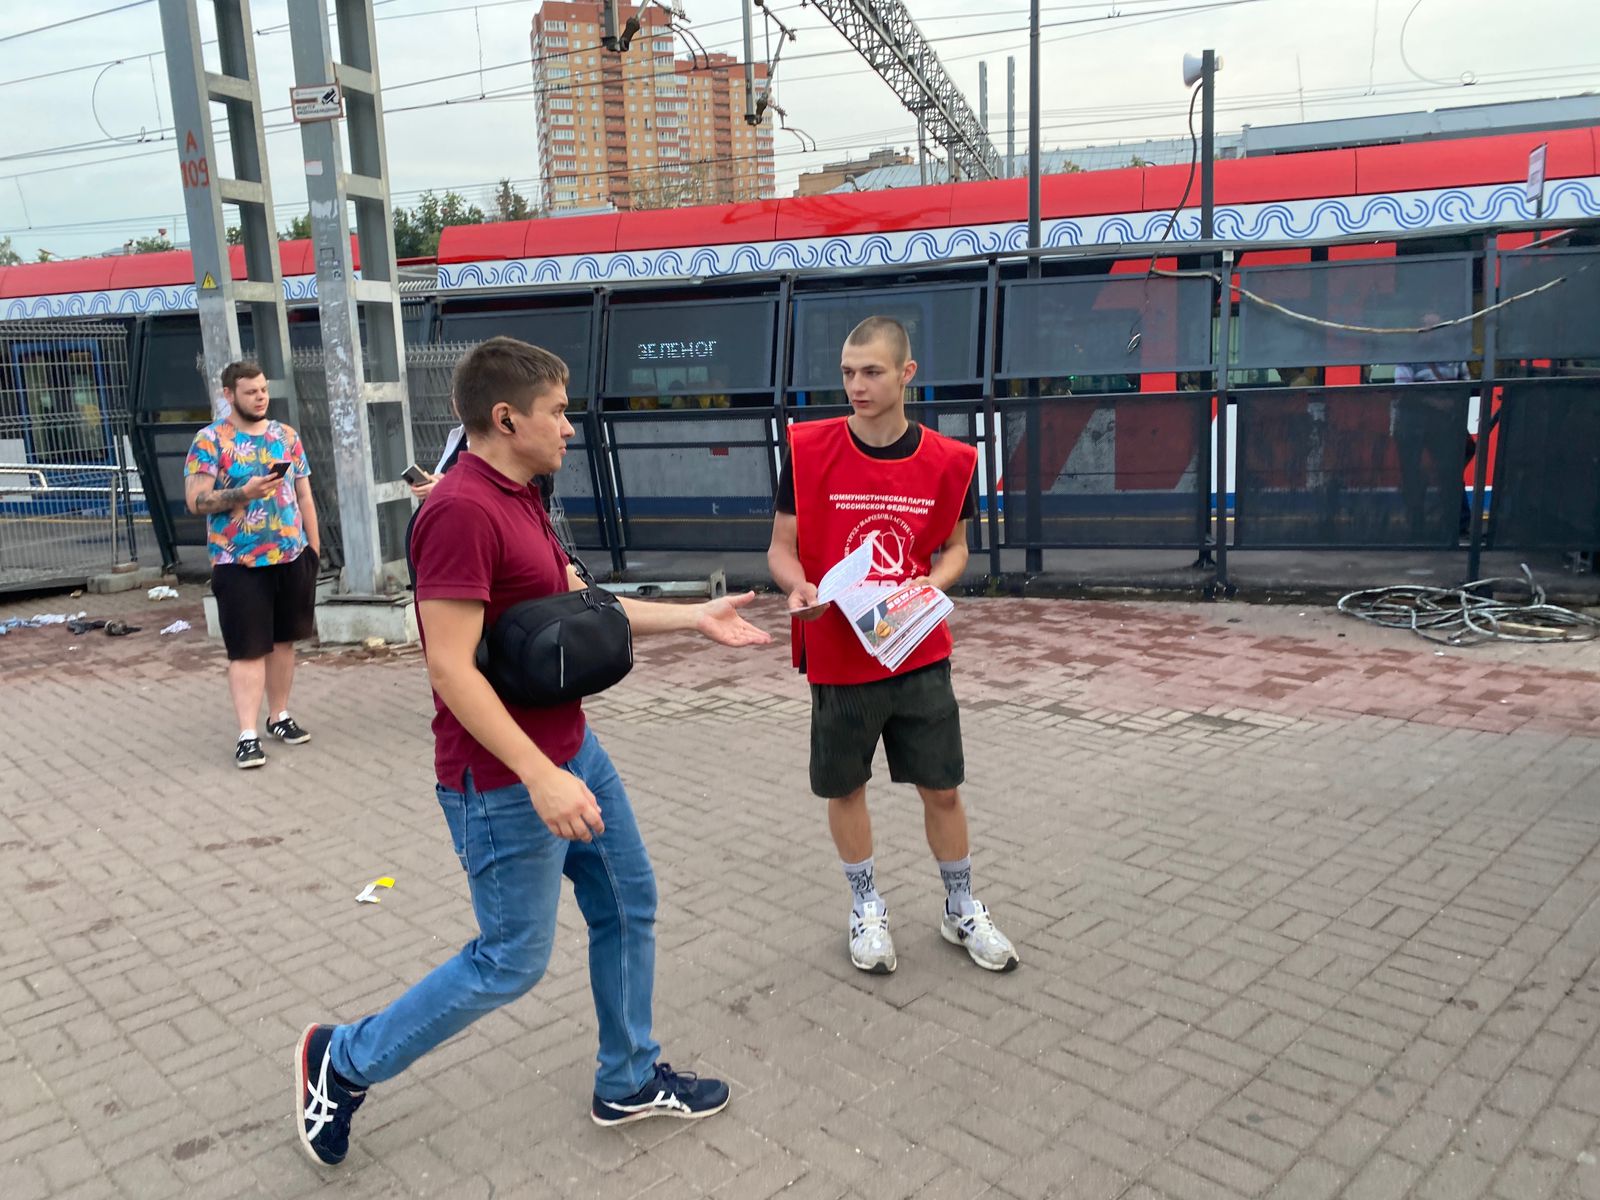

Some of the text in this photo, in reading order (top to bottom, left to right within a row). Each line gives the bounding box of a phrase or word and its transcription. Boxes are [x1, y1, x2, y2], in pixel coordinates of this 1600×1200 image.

[181, 157, 209, 189] 109
[829, 493, 936, 507] КОММУНИСТИЧЕСКАЯ ПАРТИЯ
[835, 502, 929, 515] РОССИЙСКОЙ ФЕДЕРАЦИИ
[859, 513, 912, 534] НАРОДОВЛАСТИЕ
